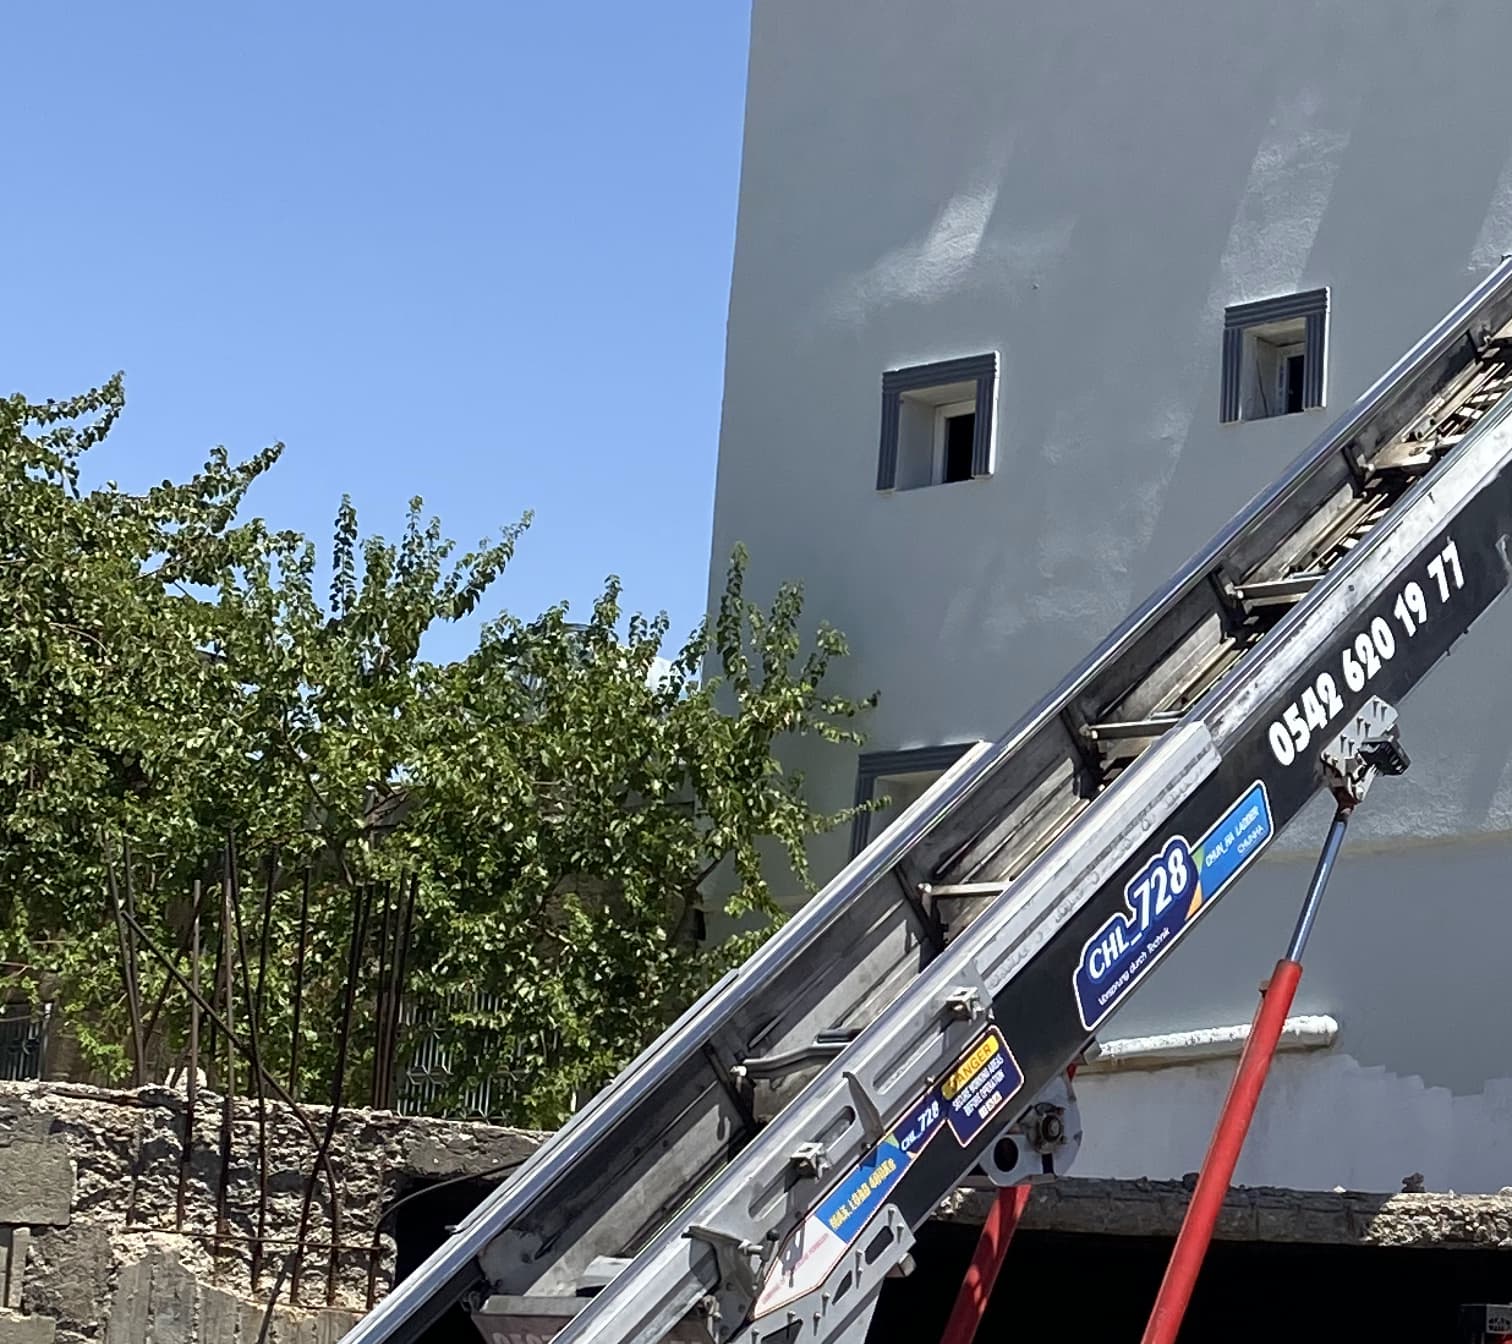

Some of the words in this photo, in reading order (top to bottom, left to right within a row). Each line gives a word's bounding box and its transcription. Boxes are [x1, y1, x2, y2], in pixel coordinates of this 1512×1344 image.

[1268, 672, 1344, 766] 0542
[1342, 616, 1396, 692] 620
[1394, 581, 1428, 638] 19
[1427, 542, 1464, 603] 77
